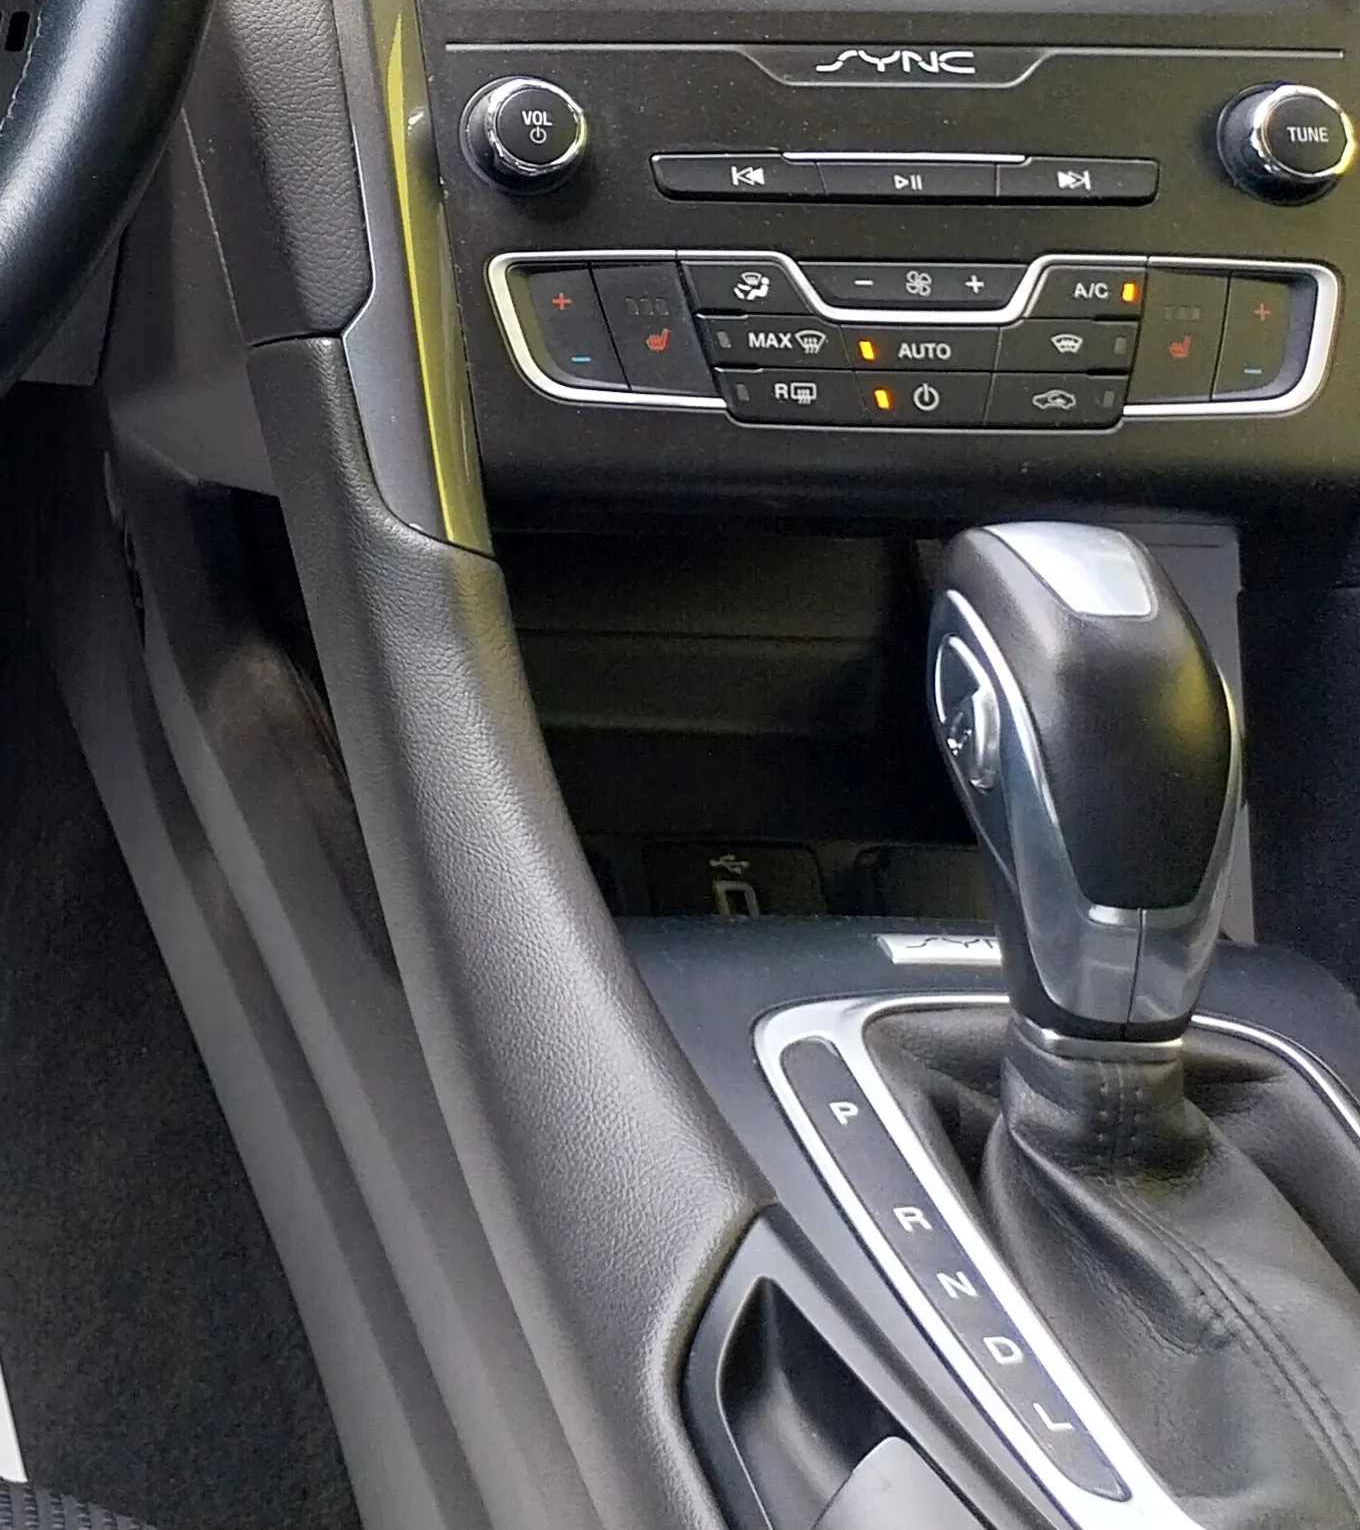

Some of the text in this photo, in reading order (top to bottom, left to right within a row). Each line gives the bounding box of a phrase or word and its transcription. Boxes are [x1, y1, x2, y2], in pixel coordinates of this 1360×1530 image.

[816, 50, 976, 74] SYNC
[522, 110, 553, 129] VOL
[1287, 126, 1330, 144] TUNE
[1073, 281, 1109, 301] A/C
[748, 331, 793, 351] MAX
[898, 341, 952, 362] AUTO
[829, 1101, 860, 1125] P
[894, 1205, 933, 1233] R
[937, 1269, 980, 1299] N
[983, 1334, 1023, 1367] D
[1035, 1402, 1072, 1431] L
